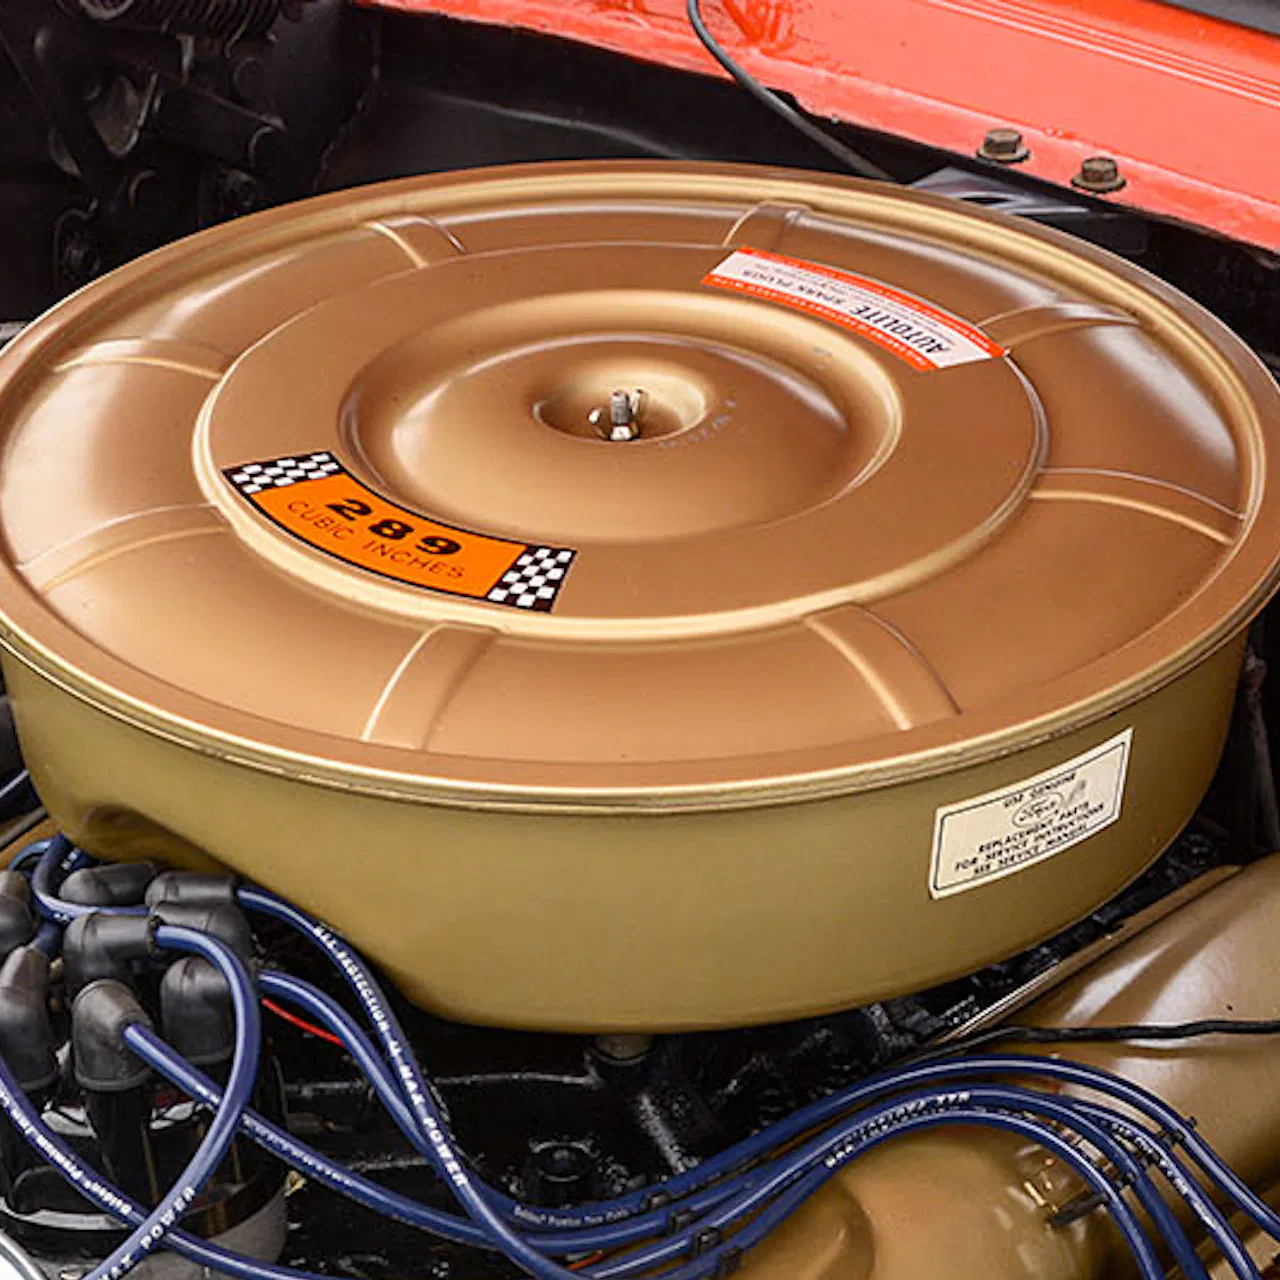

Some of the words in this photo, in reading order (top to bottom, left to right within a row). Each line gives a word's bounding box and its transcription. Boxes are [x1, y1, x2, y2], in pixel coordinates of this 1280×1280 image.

[850, 303, 951, 355] AUTOLITE
[286, 499, 356, 541] CUBIC
[362, 539, 467, 580] INCHES
[325, 498, 462, 556] 289
[955, 856, 978, 872] FOR
[978, 818, 1054, 854] REPLACEMENT
[398, 1063, 424, 1105] MAX
[422, 1116, 469, 1187] POWER
[140, 1186, 196, 1249] POWER
